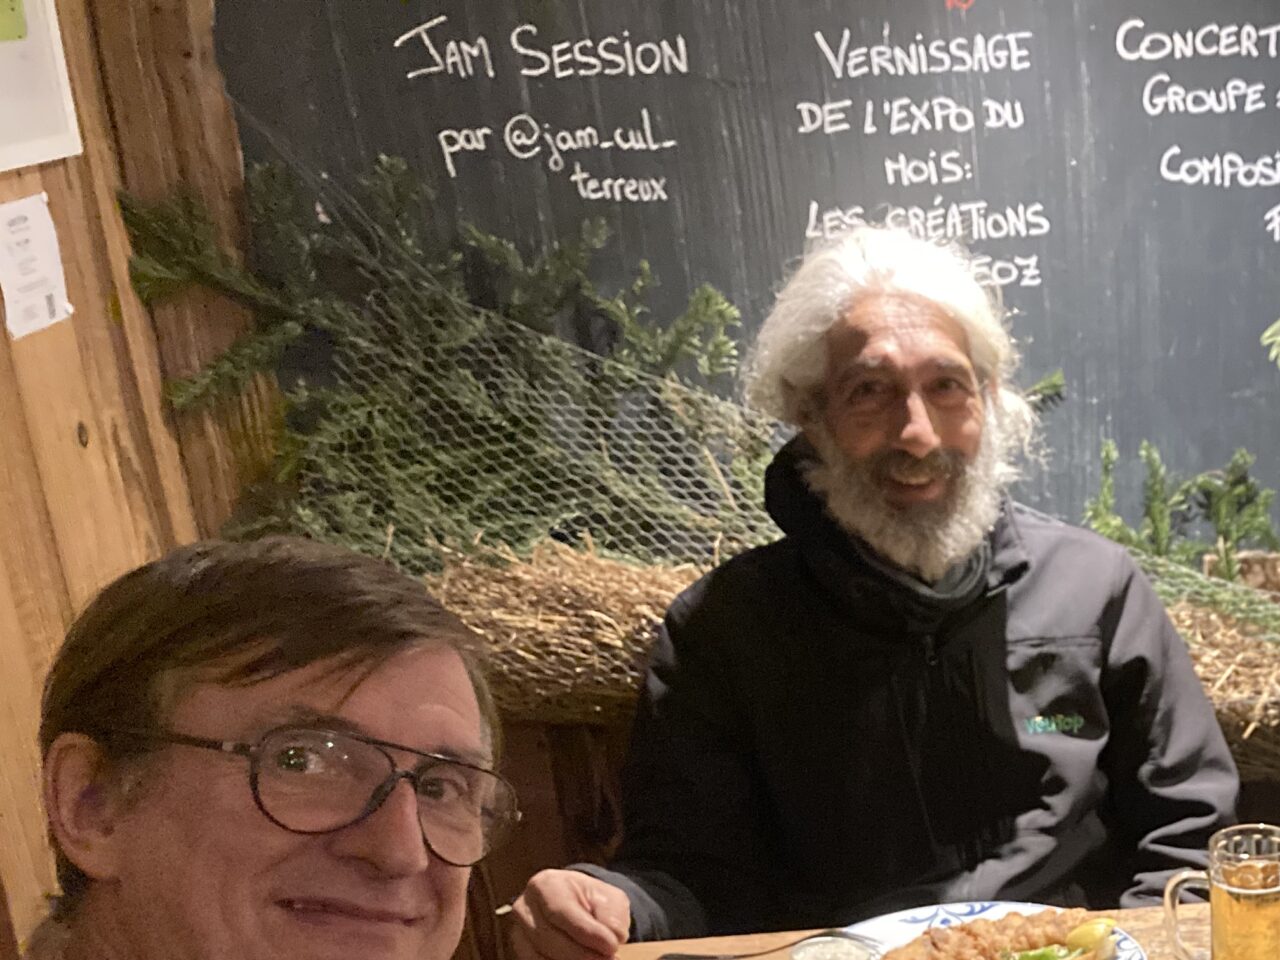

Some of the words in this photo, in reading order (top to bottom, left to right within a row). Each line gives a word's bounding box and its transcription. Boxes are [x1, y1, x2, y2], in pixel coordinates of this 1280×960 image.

[393, 15, 495, 78] JAM
[510, 24, 688, 78] SESSION
[814, 28, 1032, 78] VERNISSAGE
[796, 99, 852, 134] DE
[864, 97, 975, 135] L'EXPO
[983, 98, 1024, 129] DU
[1142, 73, 1266, 116] GROUPE
[438, 126, 493, 178] par
[884, 149, 973, 186] MOIS:
[570, 161, 668, 201] terreux
[805, 199, 864, 239] LES
[886, 193, 1051, 241] CRÉATIONS
